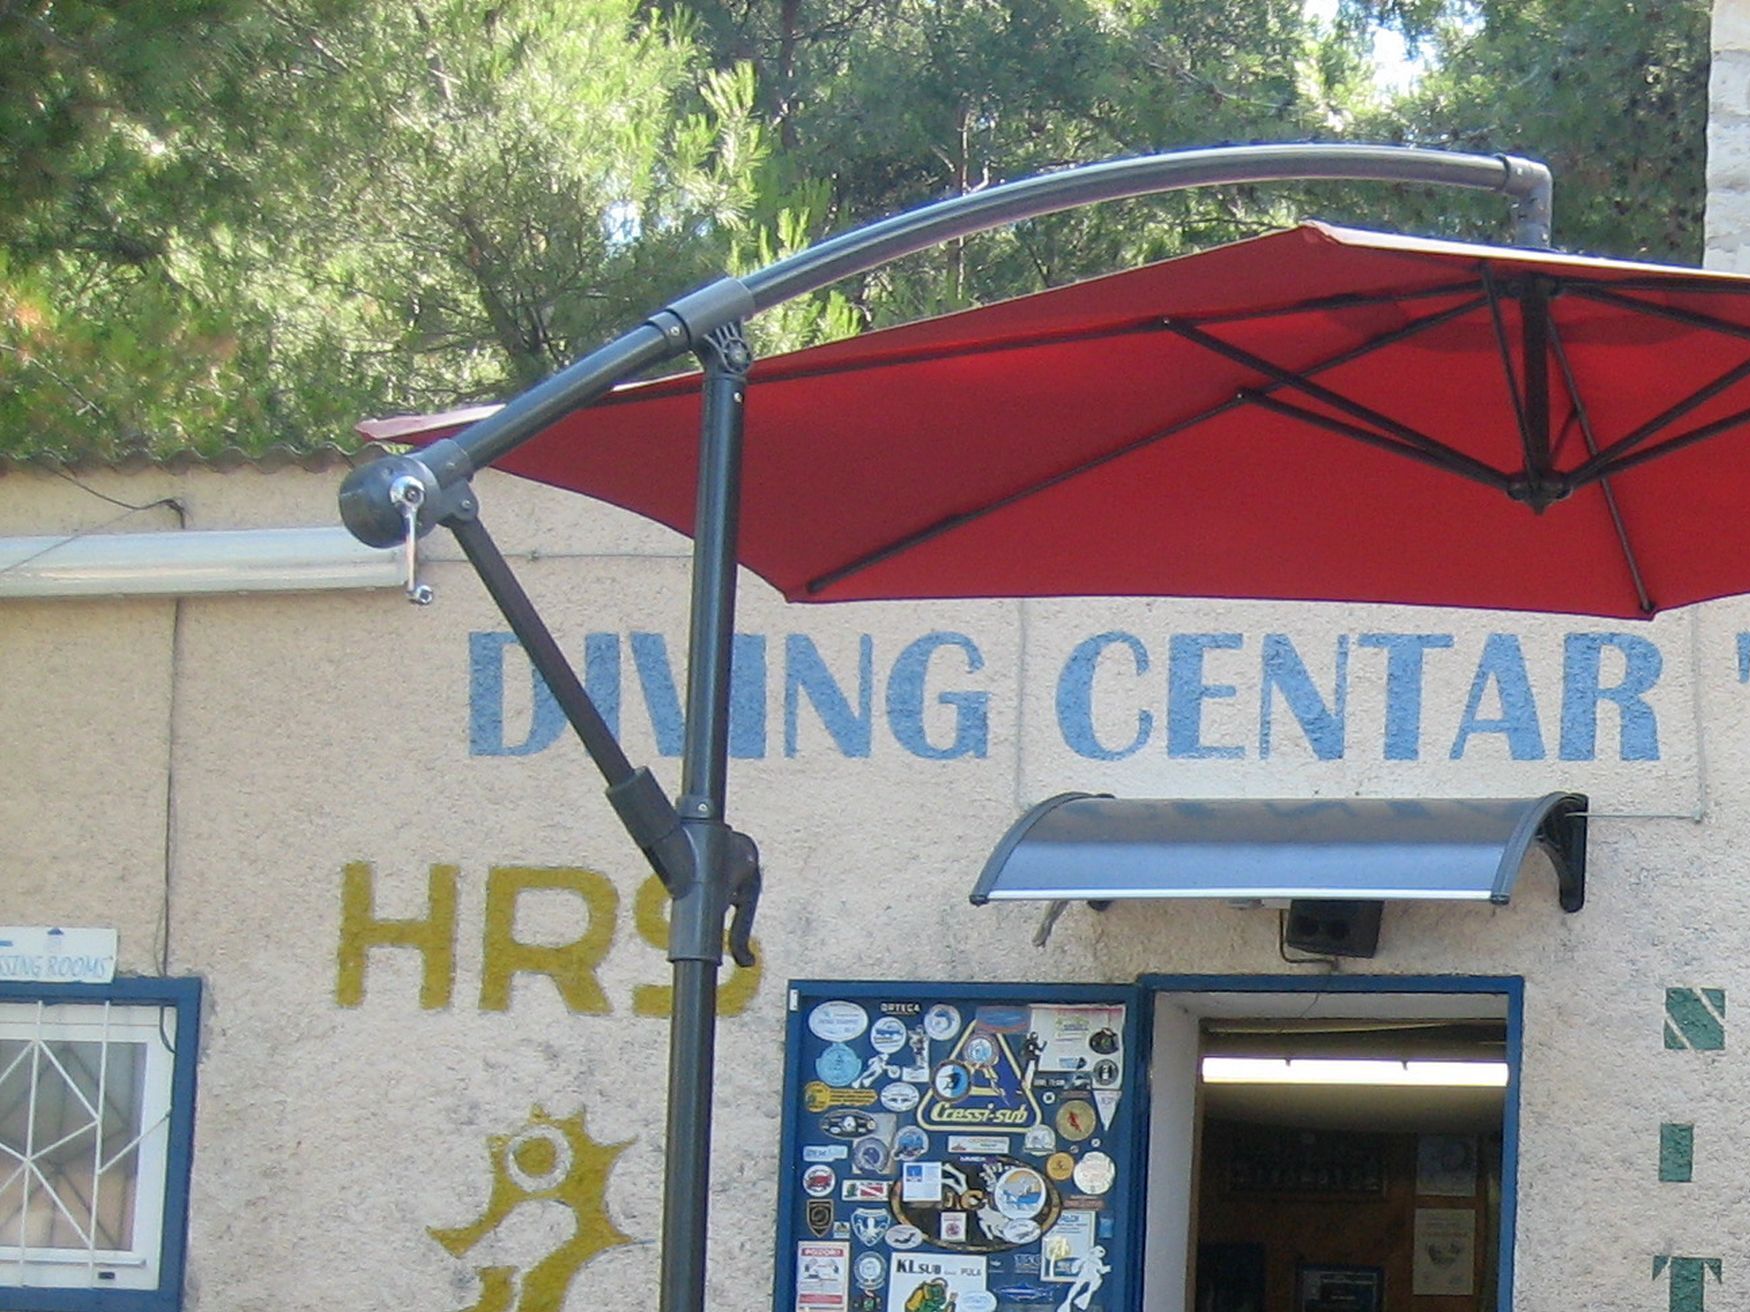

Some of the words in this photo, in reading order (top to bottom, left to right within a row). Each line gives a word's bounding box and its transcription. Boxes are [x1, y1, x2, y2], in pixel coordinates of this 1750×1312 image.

[469, 631, 989, 760] DIVING
[1055, 631, 1663, 761] CENTAR
[48, 956, 112, 979] ROOMS
[336, 861, 763, 1017] HRS
